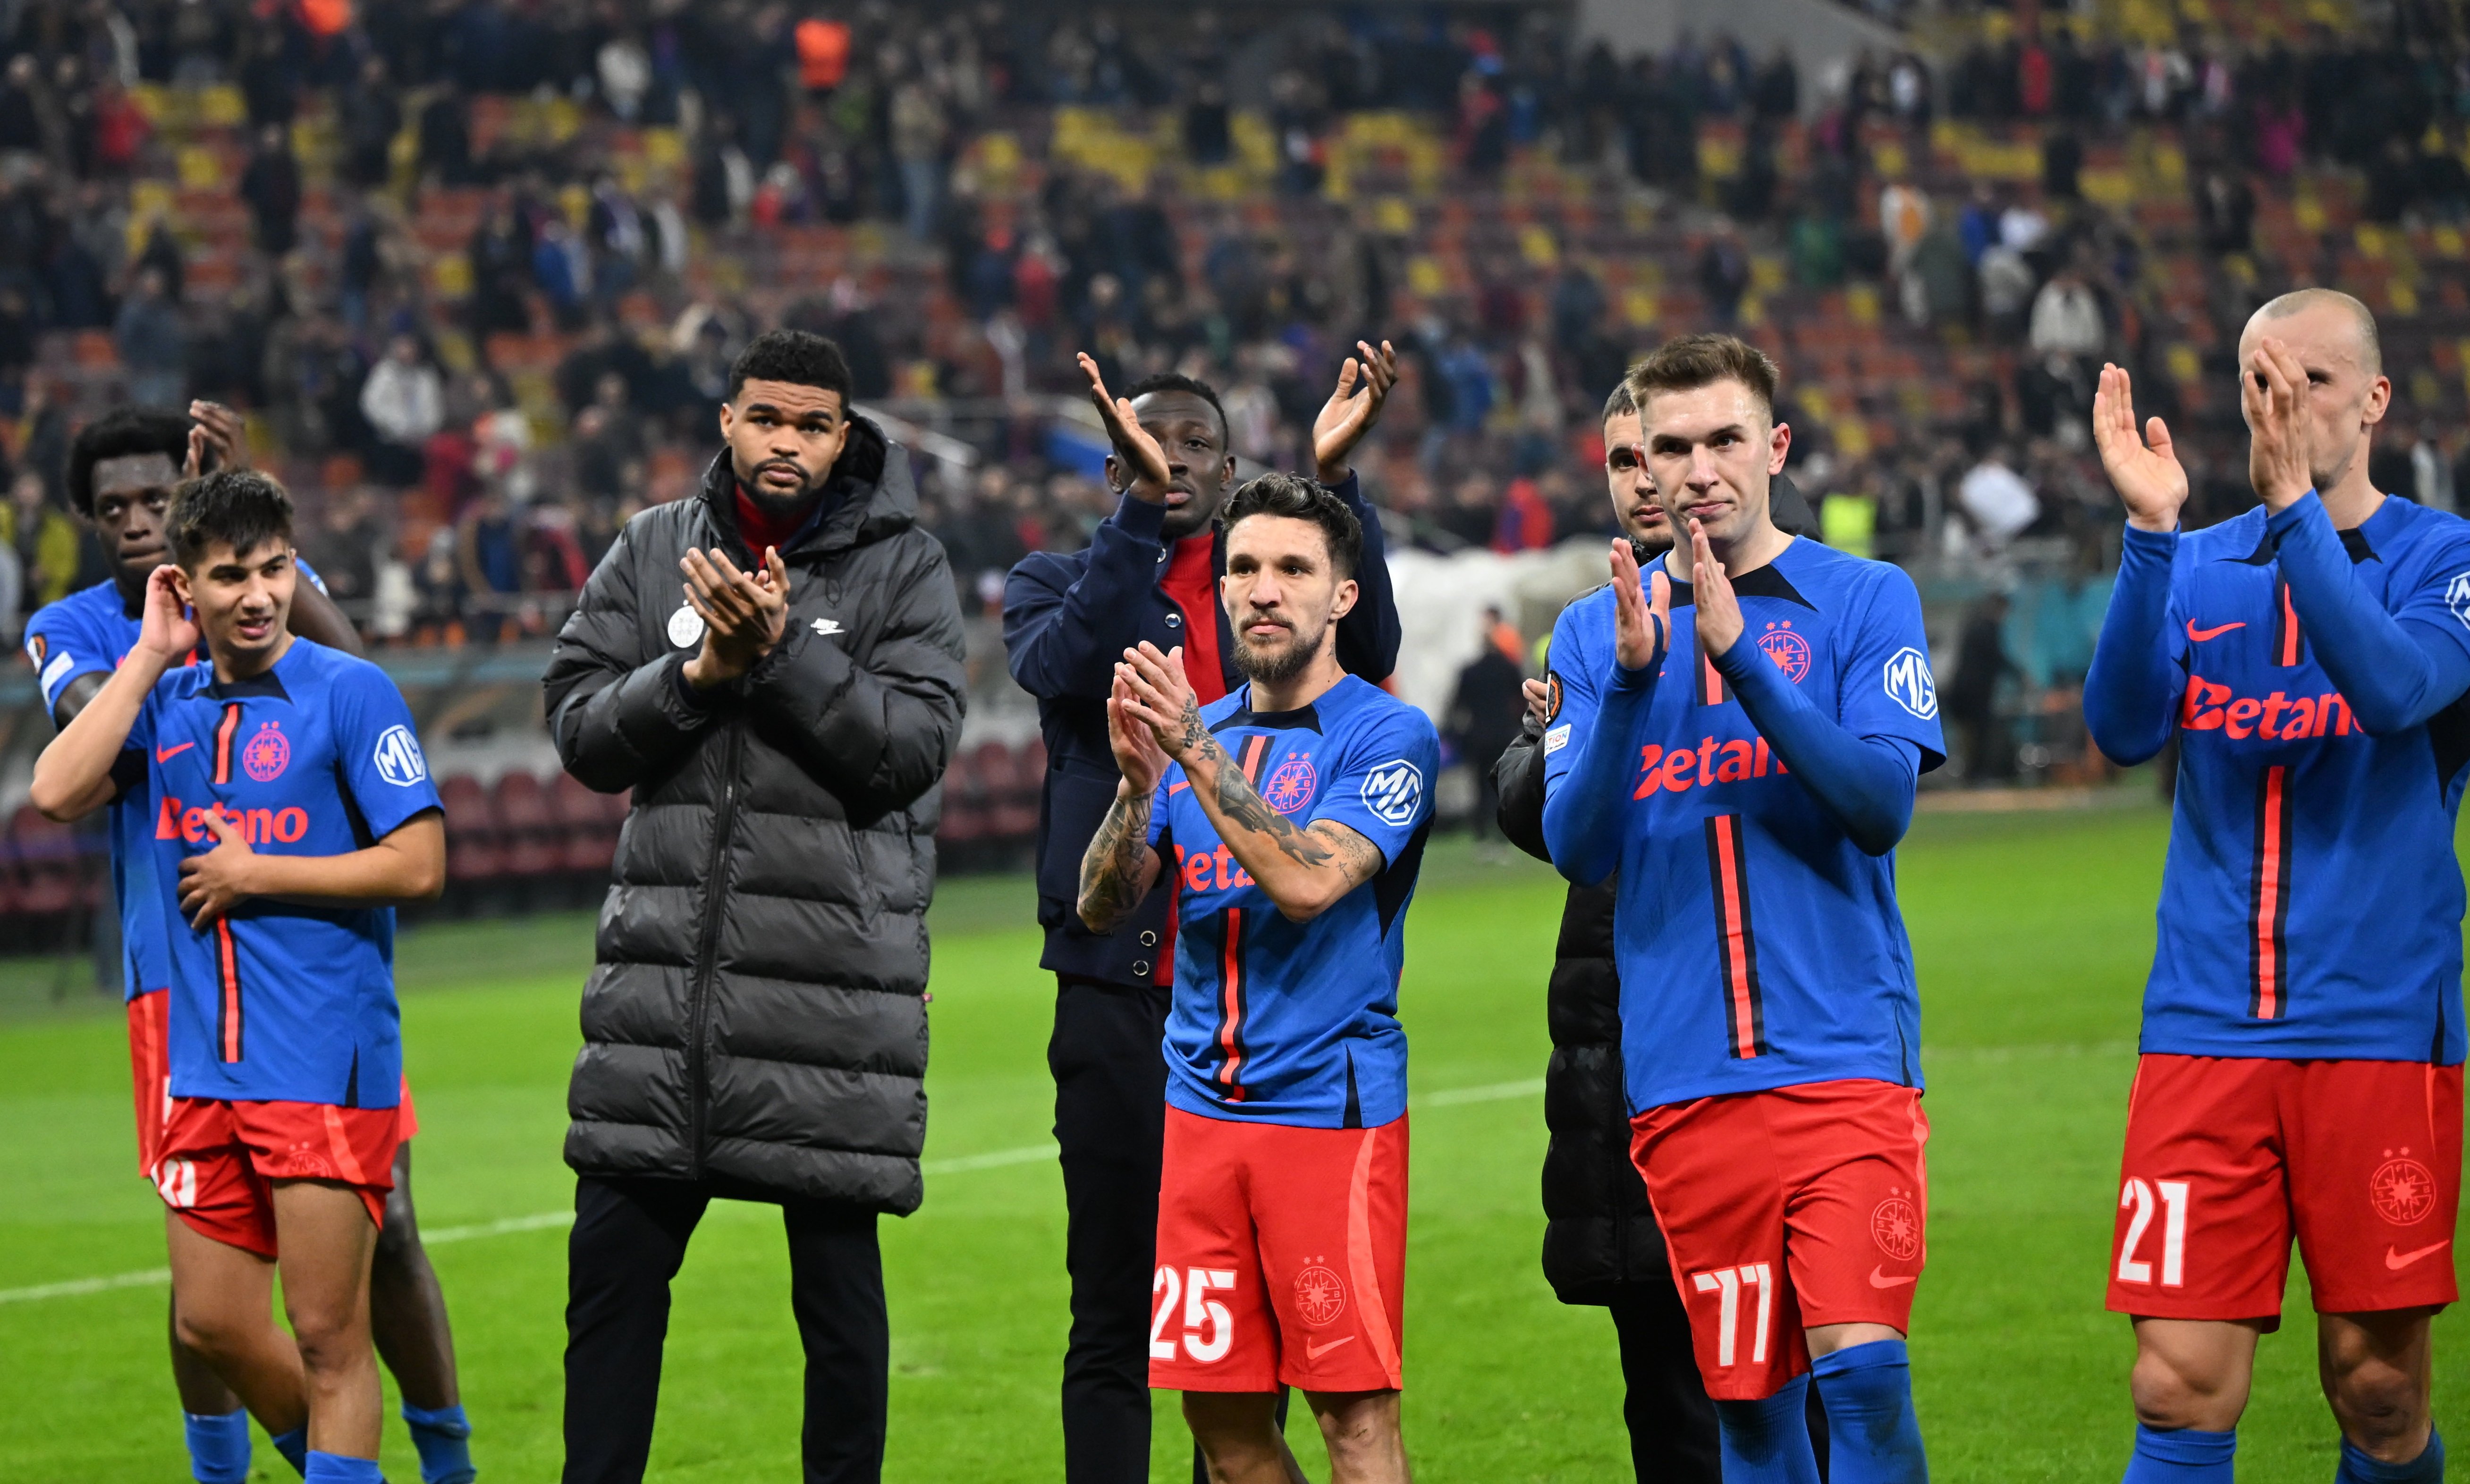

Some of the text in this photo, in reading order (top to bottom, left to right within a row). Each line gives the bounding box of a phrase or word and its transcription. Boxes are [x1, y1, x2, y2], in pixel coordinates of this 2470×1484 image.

[1891, 654, 1935, 714] MG
[2181, 675, 2364, 741] Betan
[1368, 767, 1420, 819] MG
[2116, 1176, 2191, 1288] 21
[1149, 1265, 1237, 1364] 25
[1692, 1262, 1772, 1368] 77
